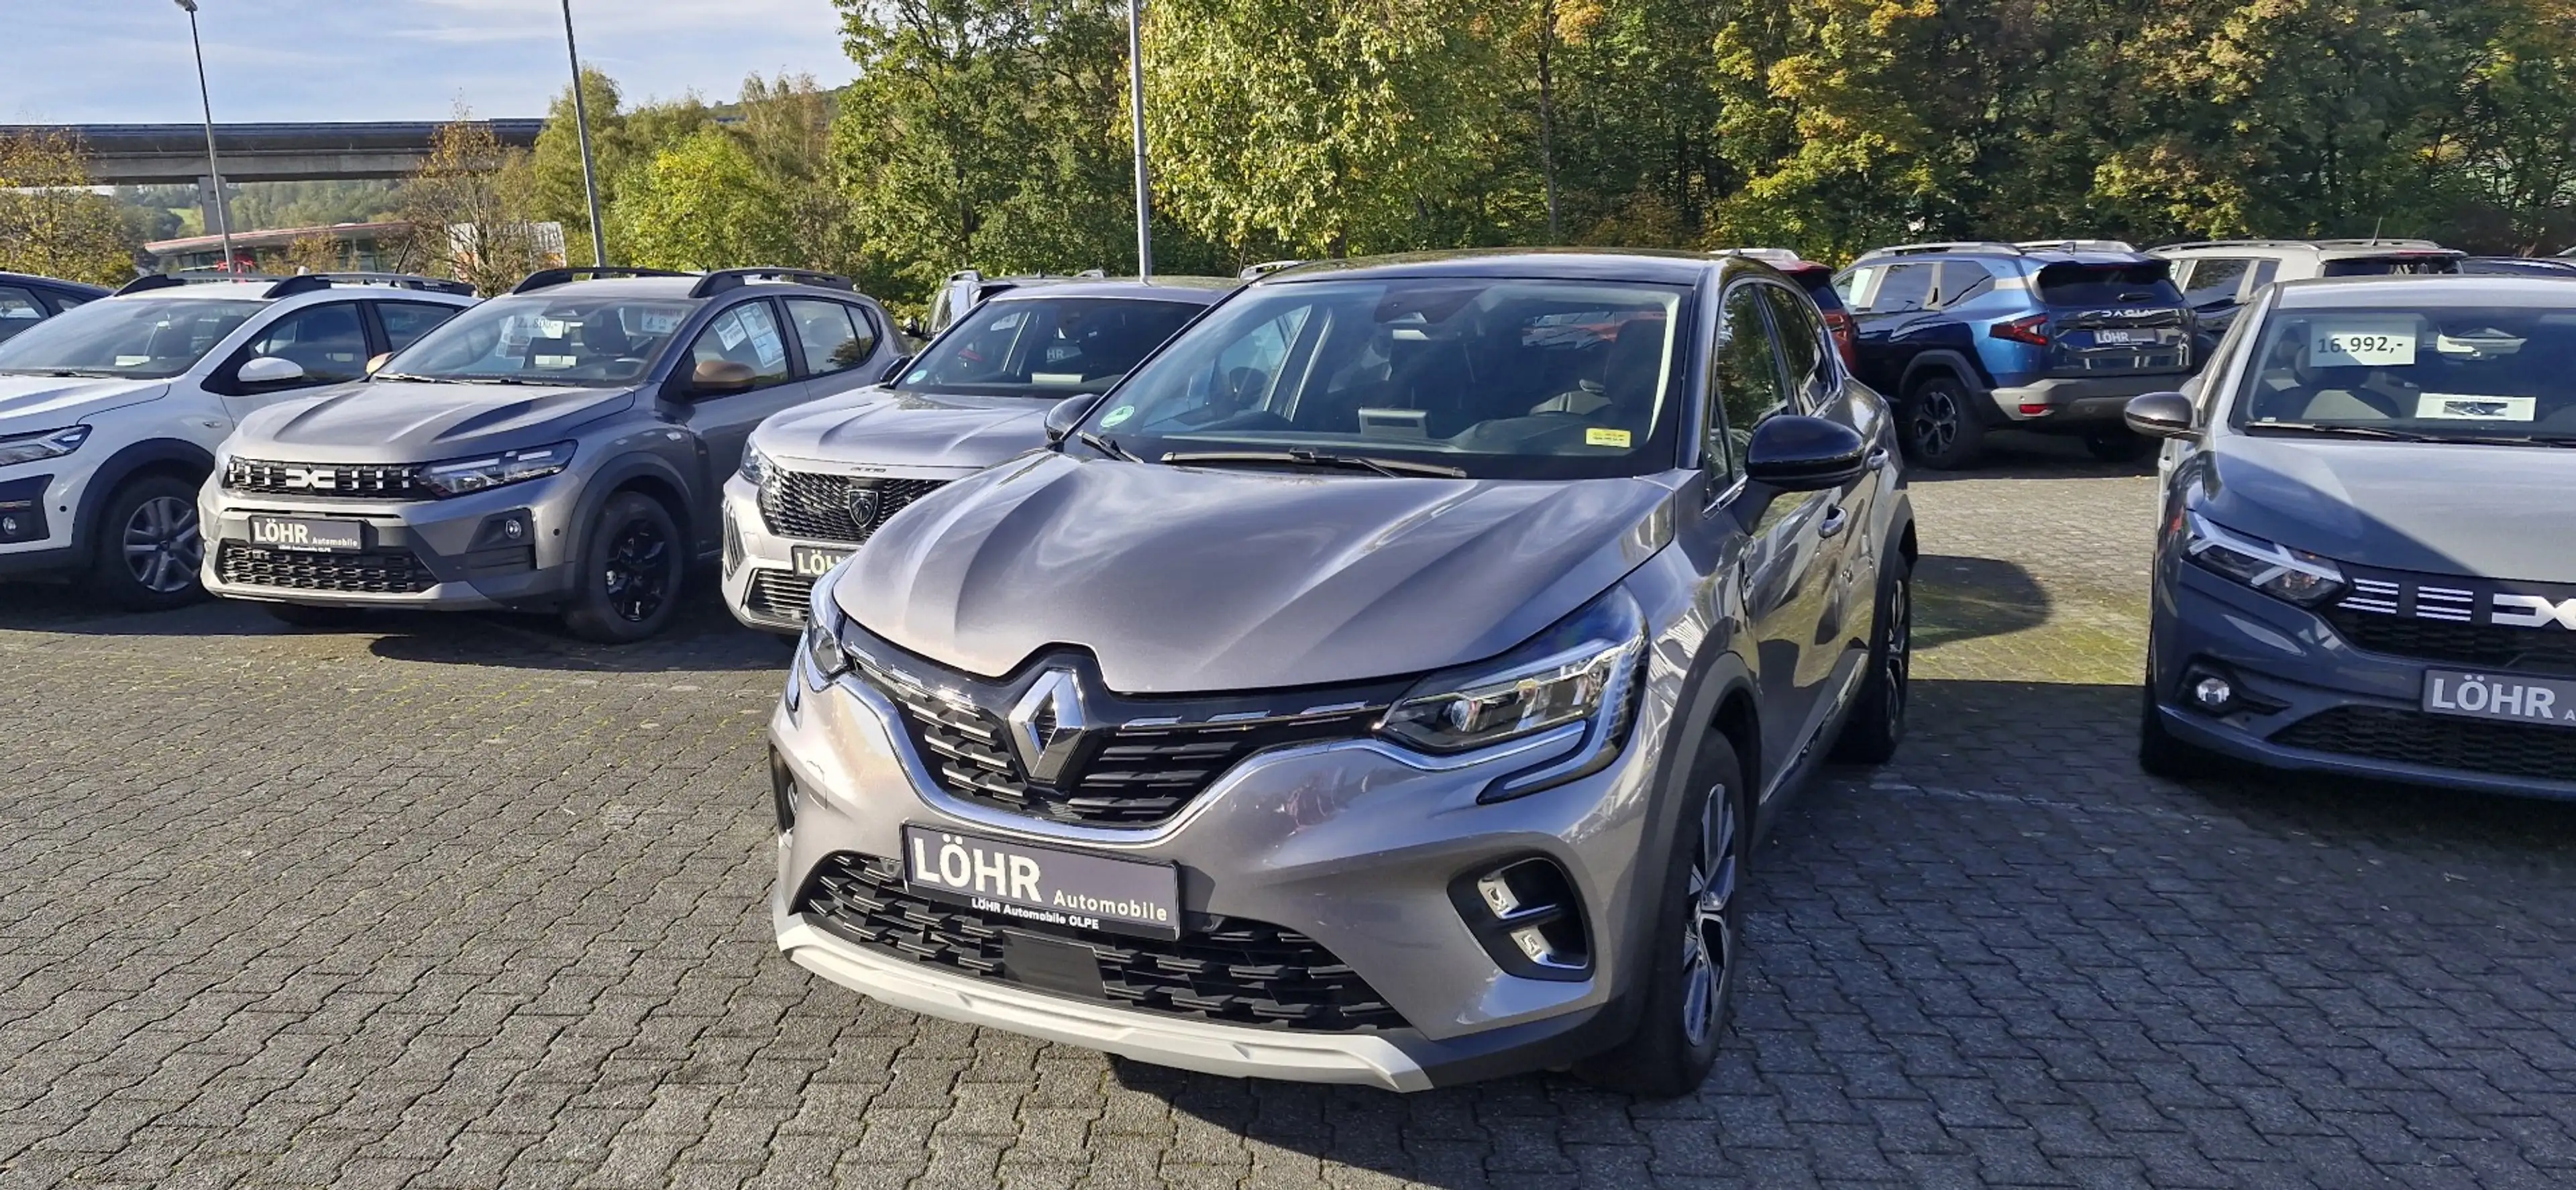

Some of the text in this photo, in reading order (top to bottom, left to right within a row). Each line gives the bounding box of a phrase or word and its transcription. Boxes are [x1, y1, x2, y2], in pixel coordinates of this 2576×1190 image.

[2096, 330, 2130, 343] LÖHR
[2317, 337, 2403, 354] 16.992,-
[254, 518, 358, 547] LÖHR Automobile
[797, 549, 847, 576] LÖH
[2432, 674, 2555, 719] LÖHR
[914, 833, 1167, 921] LÖHR Automobile
[971, 898, 1099, 930] LÖHR Automobile OLPE
